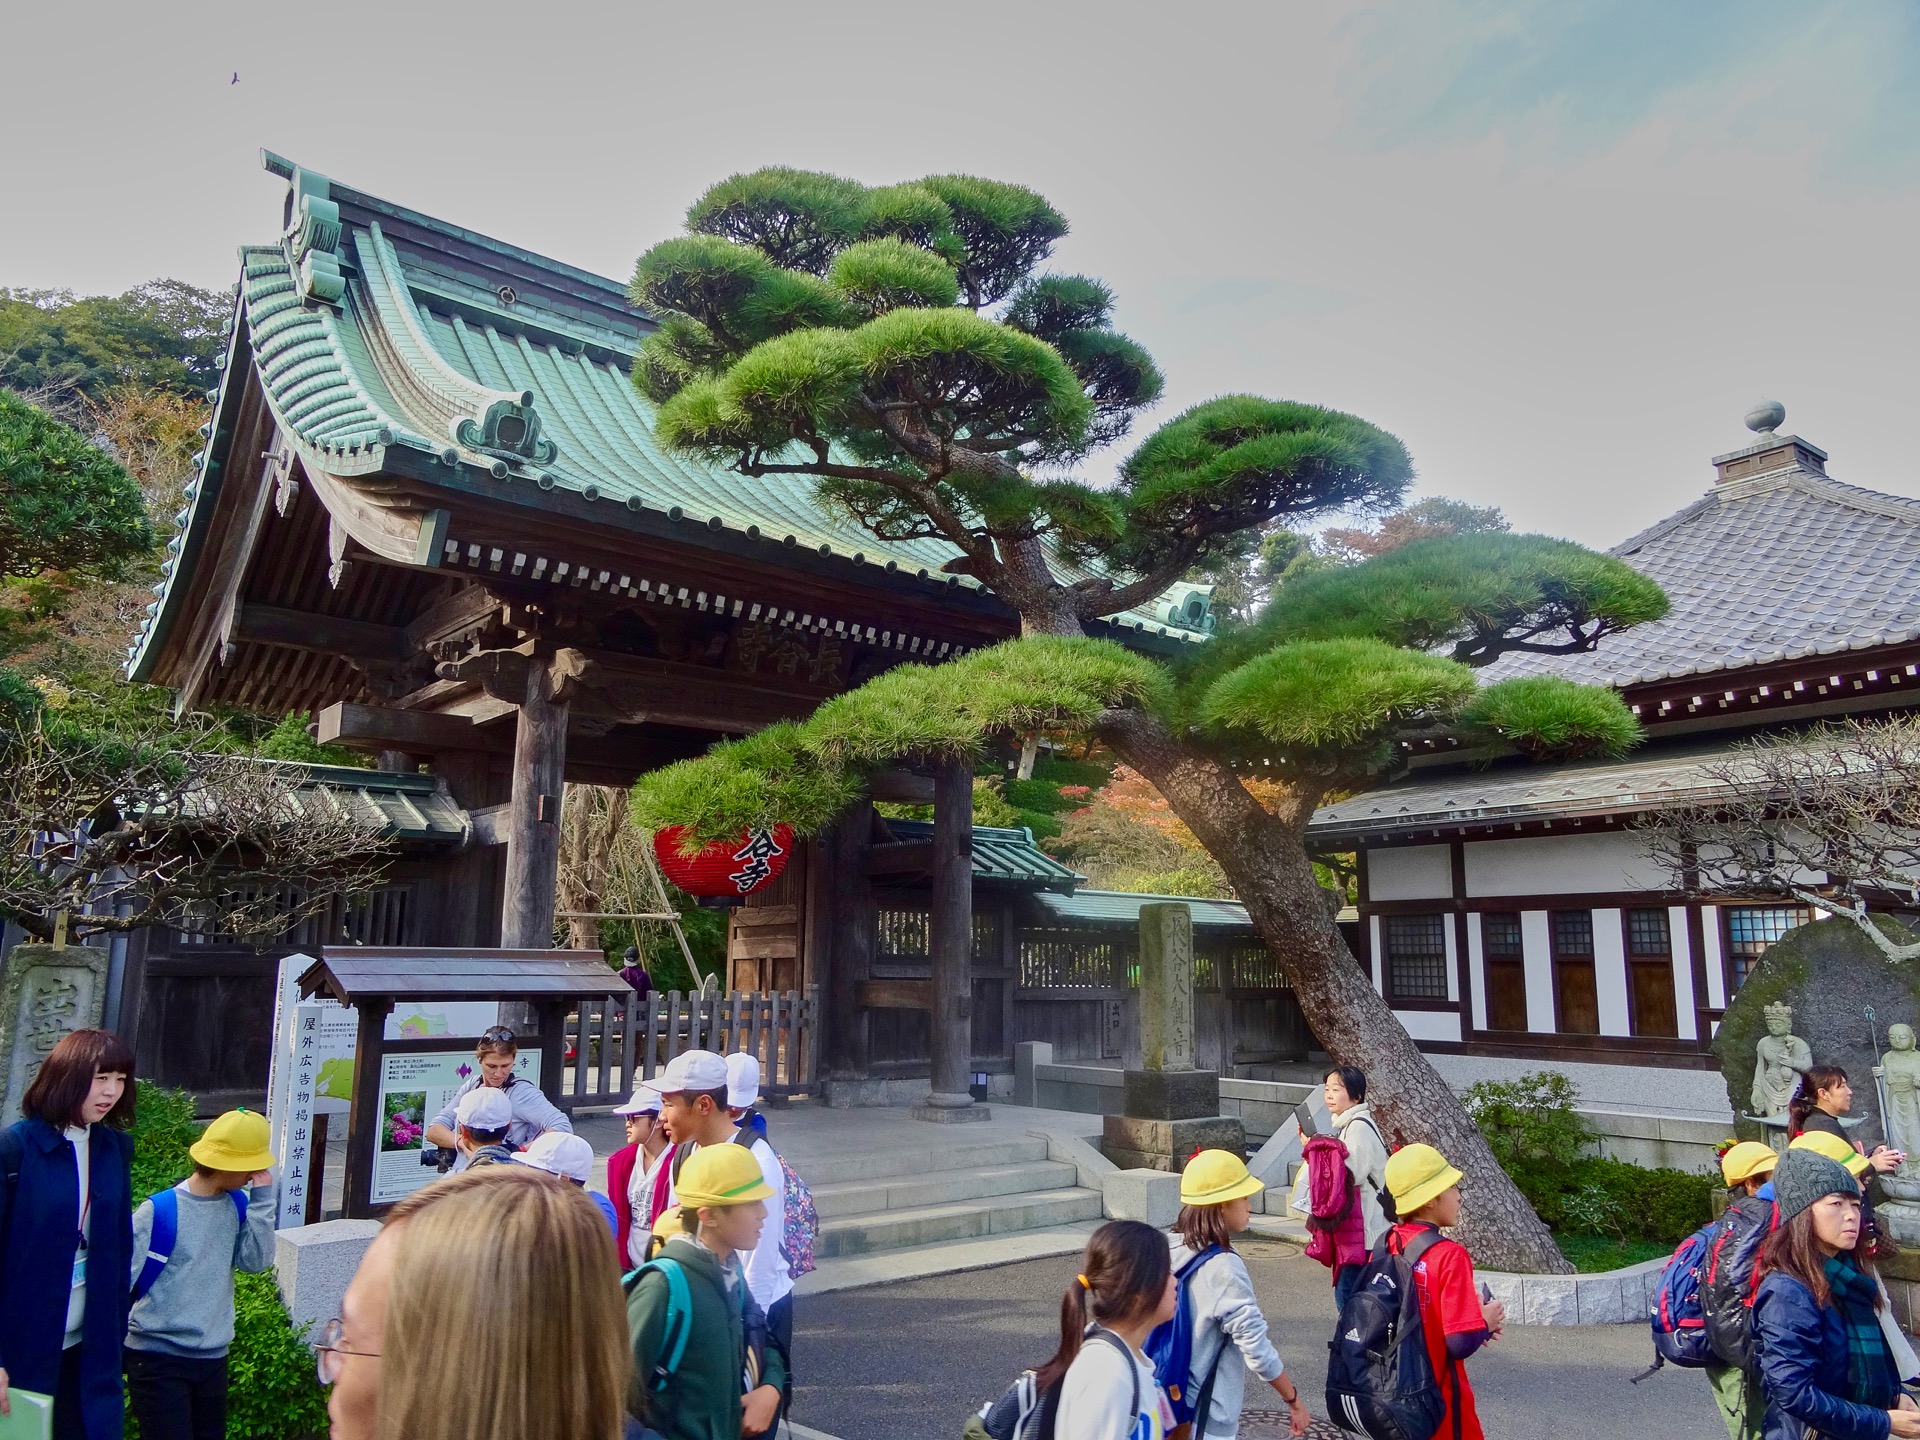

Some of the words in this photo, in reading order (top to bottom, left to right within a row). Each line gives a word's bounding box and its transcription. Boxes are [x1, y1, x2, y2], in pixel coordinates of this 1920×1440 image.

[1112, 1002, 1120, 1028] 出口
[287, 1017, 316, 1216] 屋外広告物掲出禁止地域
